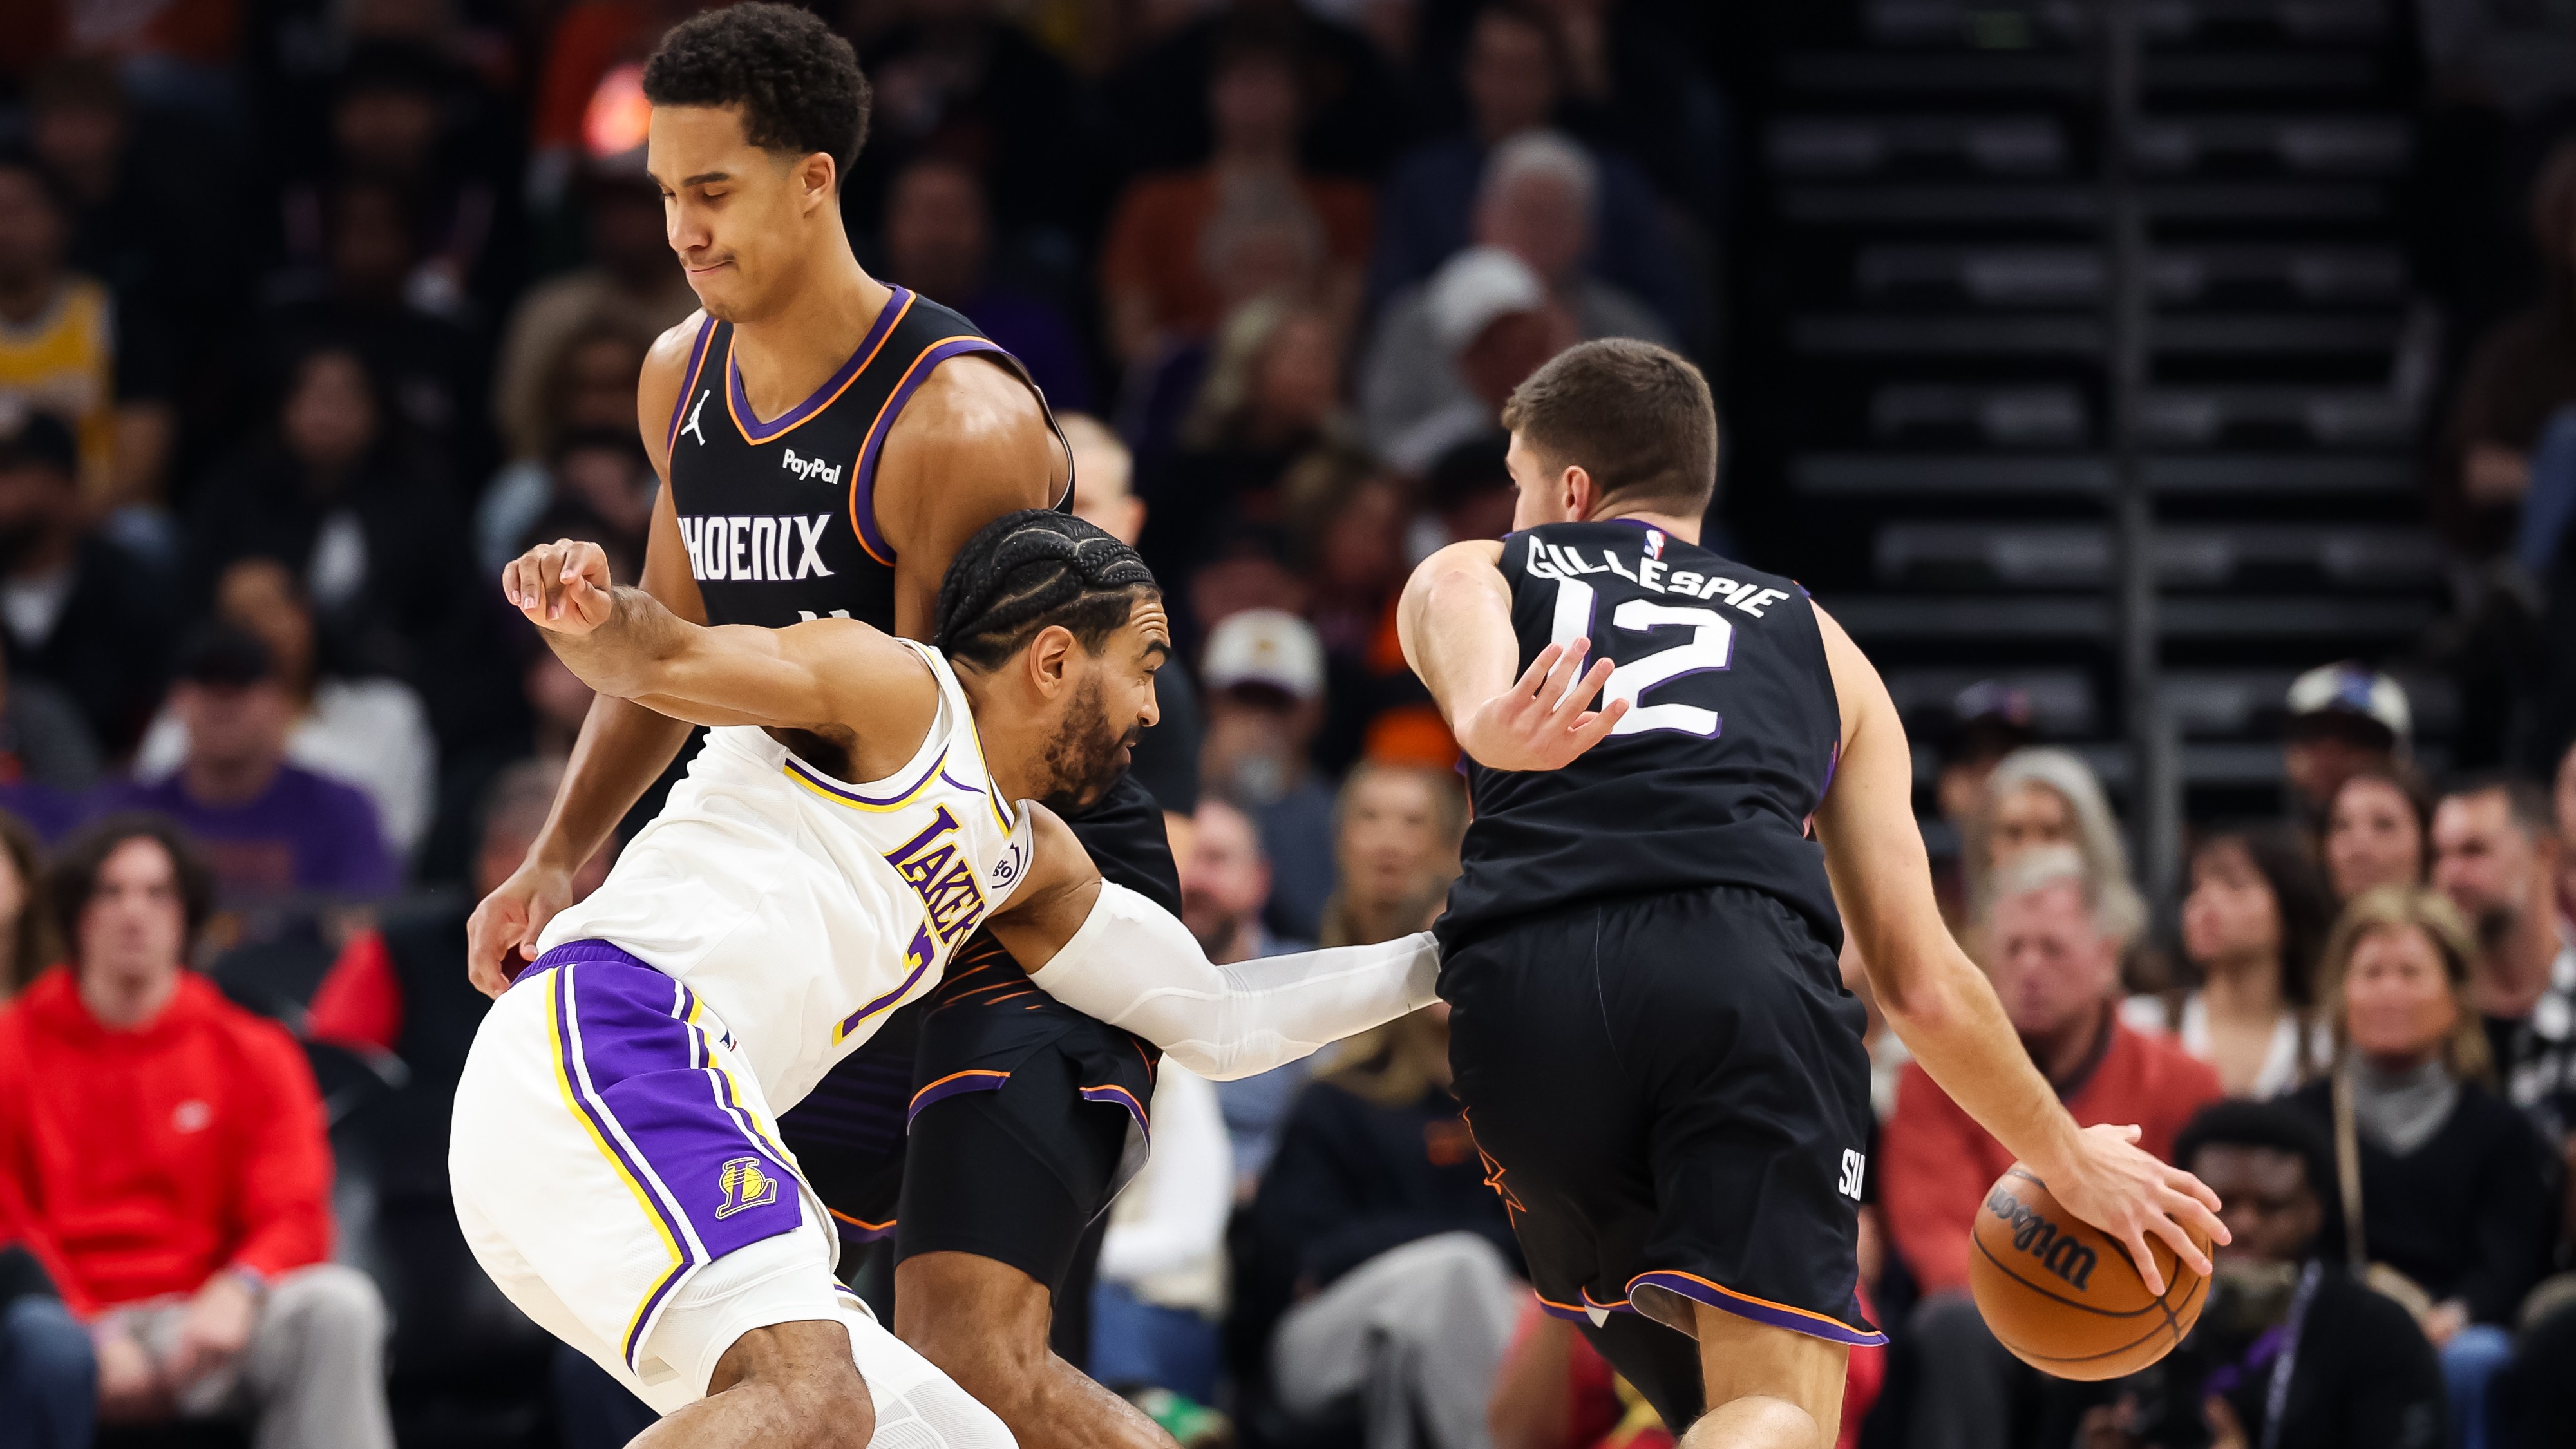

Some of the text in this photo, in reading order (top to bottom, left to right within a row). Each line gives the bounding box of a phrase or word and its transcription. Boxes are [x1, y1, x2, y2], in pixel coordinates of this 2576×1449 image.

[782, 448, 842, 485] PayPal
[1526, 534, 1790, 618] GILLESPIE
[1548, 577, 1737, 740] 12
[883, 802, 987, 949] LAKER
[1838, 1148, 1866, 1202] SU
[1987, 1184, 2098, 1292] Wilson
